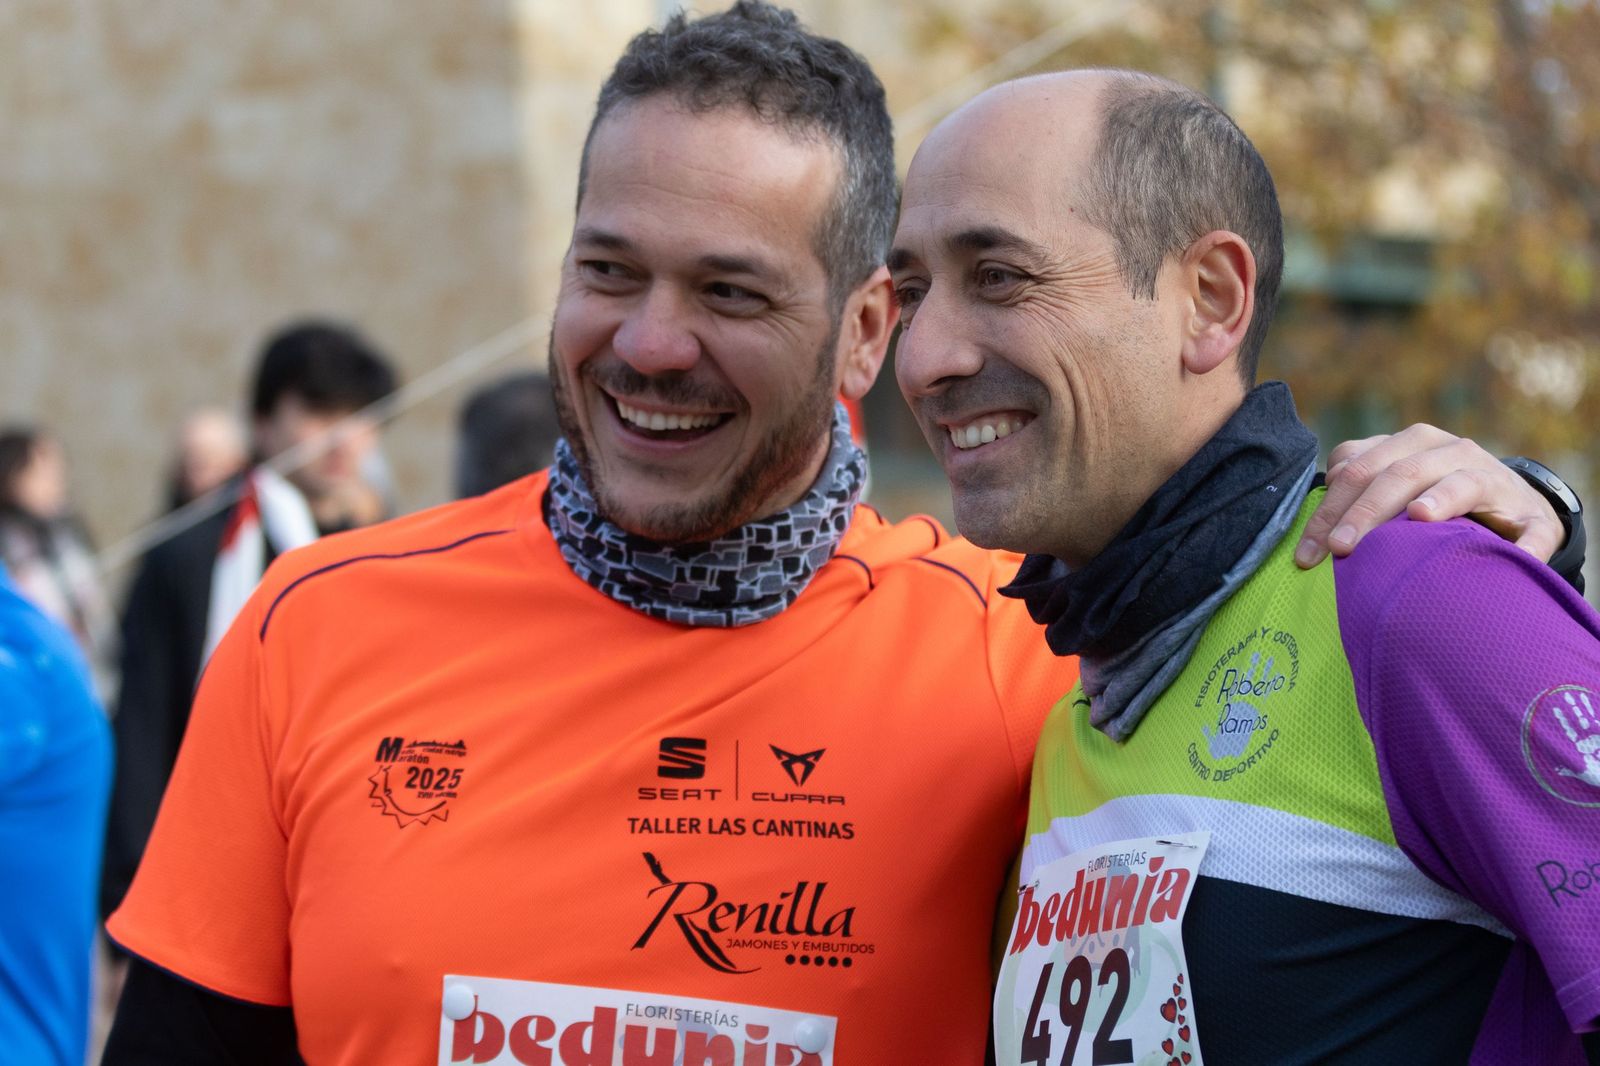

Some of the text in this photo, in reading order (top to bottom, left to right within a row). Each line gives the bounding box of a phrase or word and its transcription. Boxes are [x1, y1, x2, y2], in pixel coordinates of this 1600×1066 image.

[1261, 626, 1271, 639] Y
[1218, 703, 1268, 735] Ramos
[1213, 729, 1279, 782] DEPORTIVO
[405, 766, 465, 790] 2025
[638, 787, 722, 801] SEAT
[751, 792, 846, 805] CUPRA
[627, 817, 855, 840] TALLER LAS CANTINAS
[1088, 849, 1147, 873] FLORISTERÍAS
[1009, 856, 1191, 956] bedunia
[630, 881, 857, 974] Renilla
[726, 938, 876, 954] JAMONES Y EMBUTIDOS
[625, 1002, 740, 1028] FLORISTERÍAS
[1020, 948, 1134, 1066] 492
